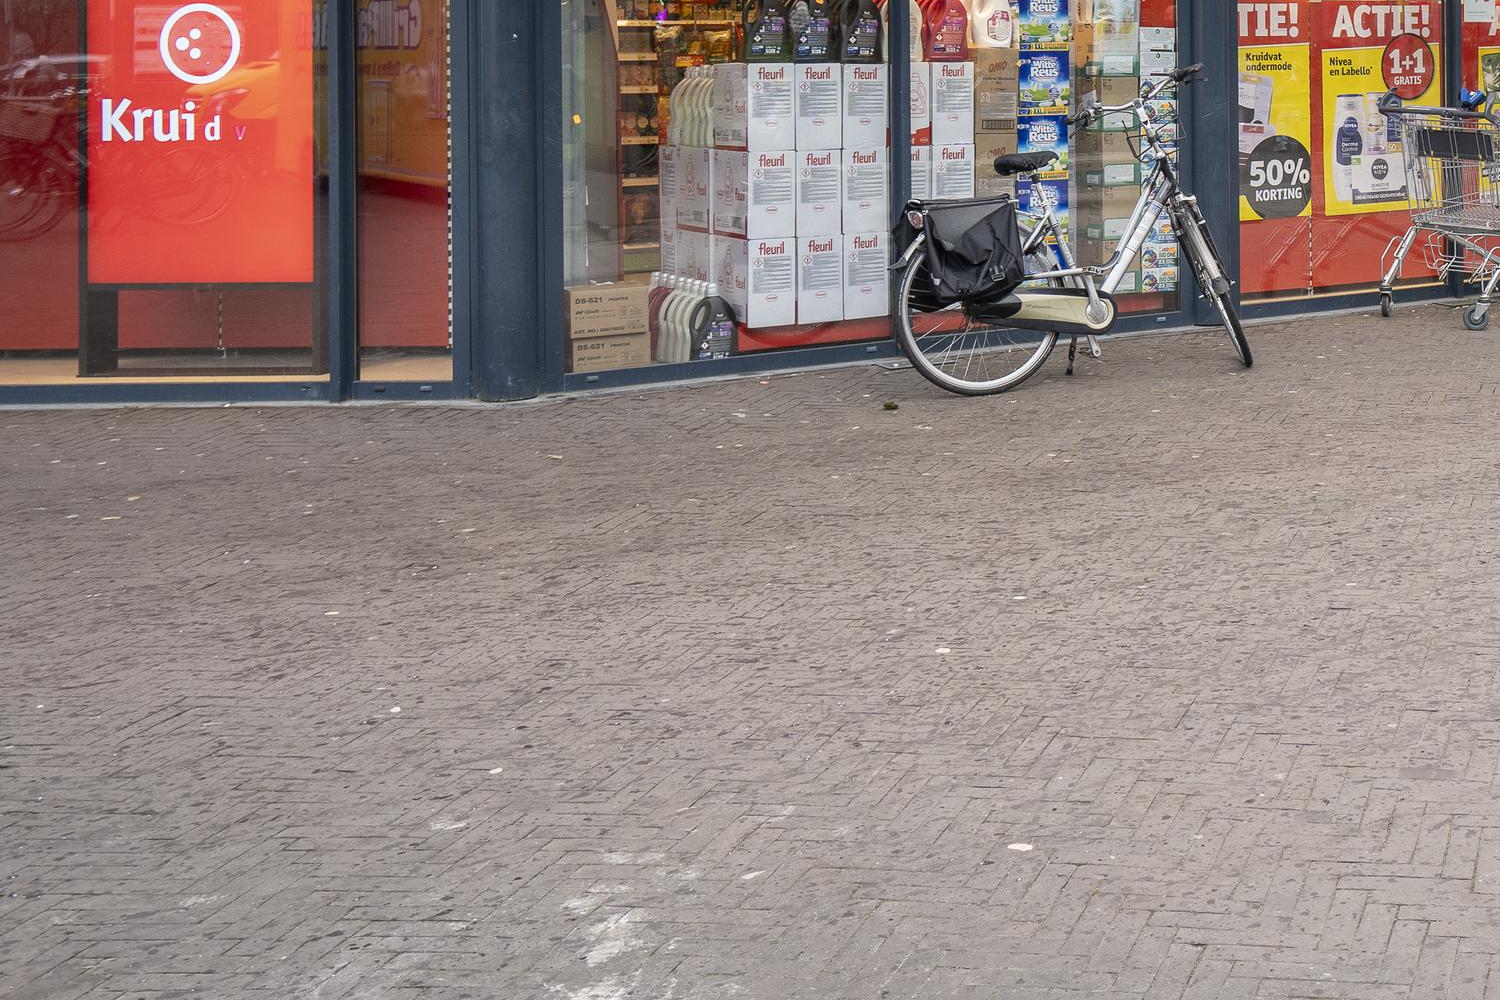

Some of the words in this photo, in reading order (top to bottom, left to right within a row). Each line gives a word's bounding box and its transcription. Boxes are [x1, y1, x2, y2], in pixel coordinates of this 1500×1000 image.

[1029, 2, 1058, 12] Reus
[1332, 4, 1431, 39] ACTIE!
[1245, 52, 1282, 62] Kruidvat
[1329, 57, 1352, 66] Nivea
[1388, 48, 1426, 74] 1+1
[988, 60, 1008, 73] OMO
[1032, 59, 1056, 69] Witte
[1246, 61, 1292, 72] ondermode
[758, 66, 784, 80] fleuril
[804, 66, 830, 80] fleuril
[853, 66, 878, 80] fleuril
[941, 64, 965, 78] fleuril
[1030, 67, 1058, 77] Reus
[1329, 69, 1340, 77] en
[1394, 75, 1422, 85] GRATIS
[1032, 124, 1056, 133] Witte
[1029, 131, 1057, 142] Reus
[758, 153, 785, 167] fleuril
[806, 152, 831, 166] fleuril
[852, 151, 876, 164] fleuril
[941, 147, 965, 160] fleuril
[1249, 158, 1310, 187] 50%
[1255, 187, 1302, 202] KORTING
[759, 241, 785, 255] fleuril
[808, 239, 833, 253] fleuril
[854, 236, 878, 249] fleuril
